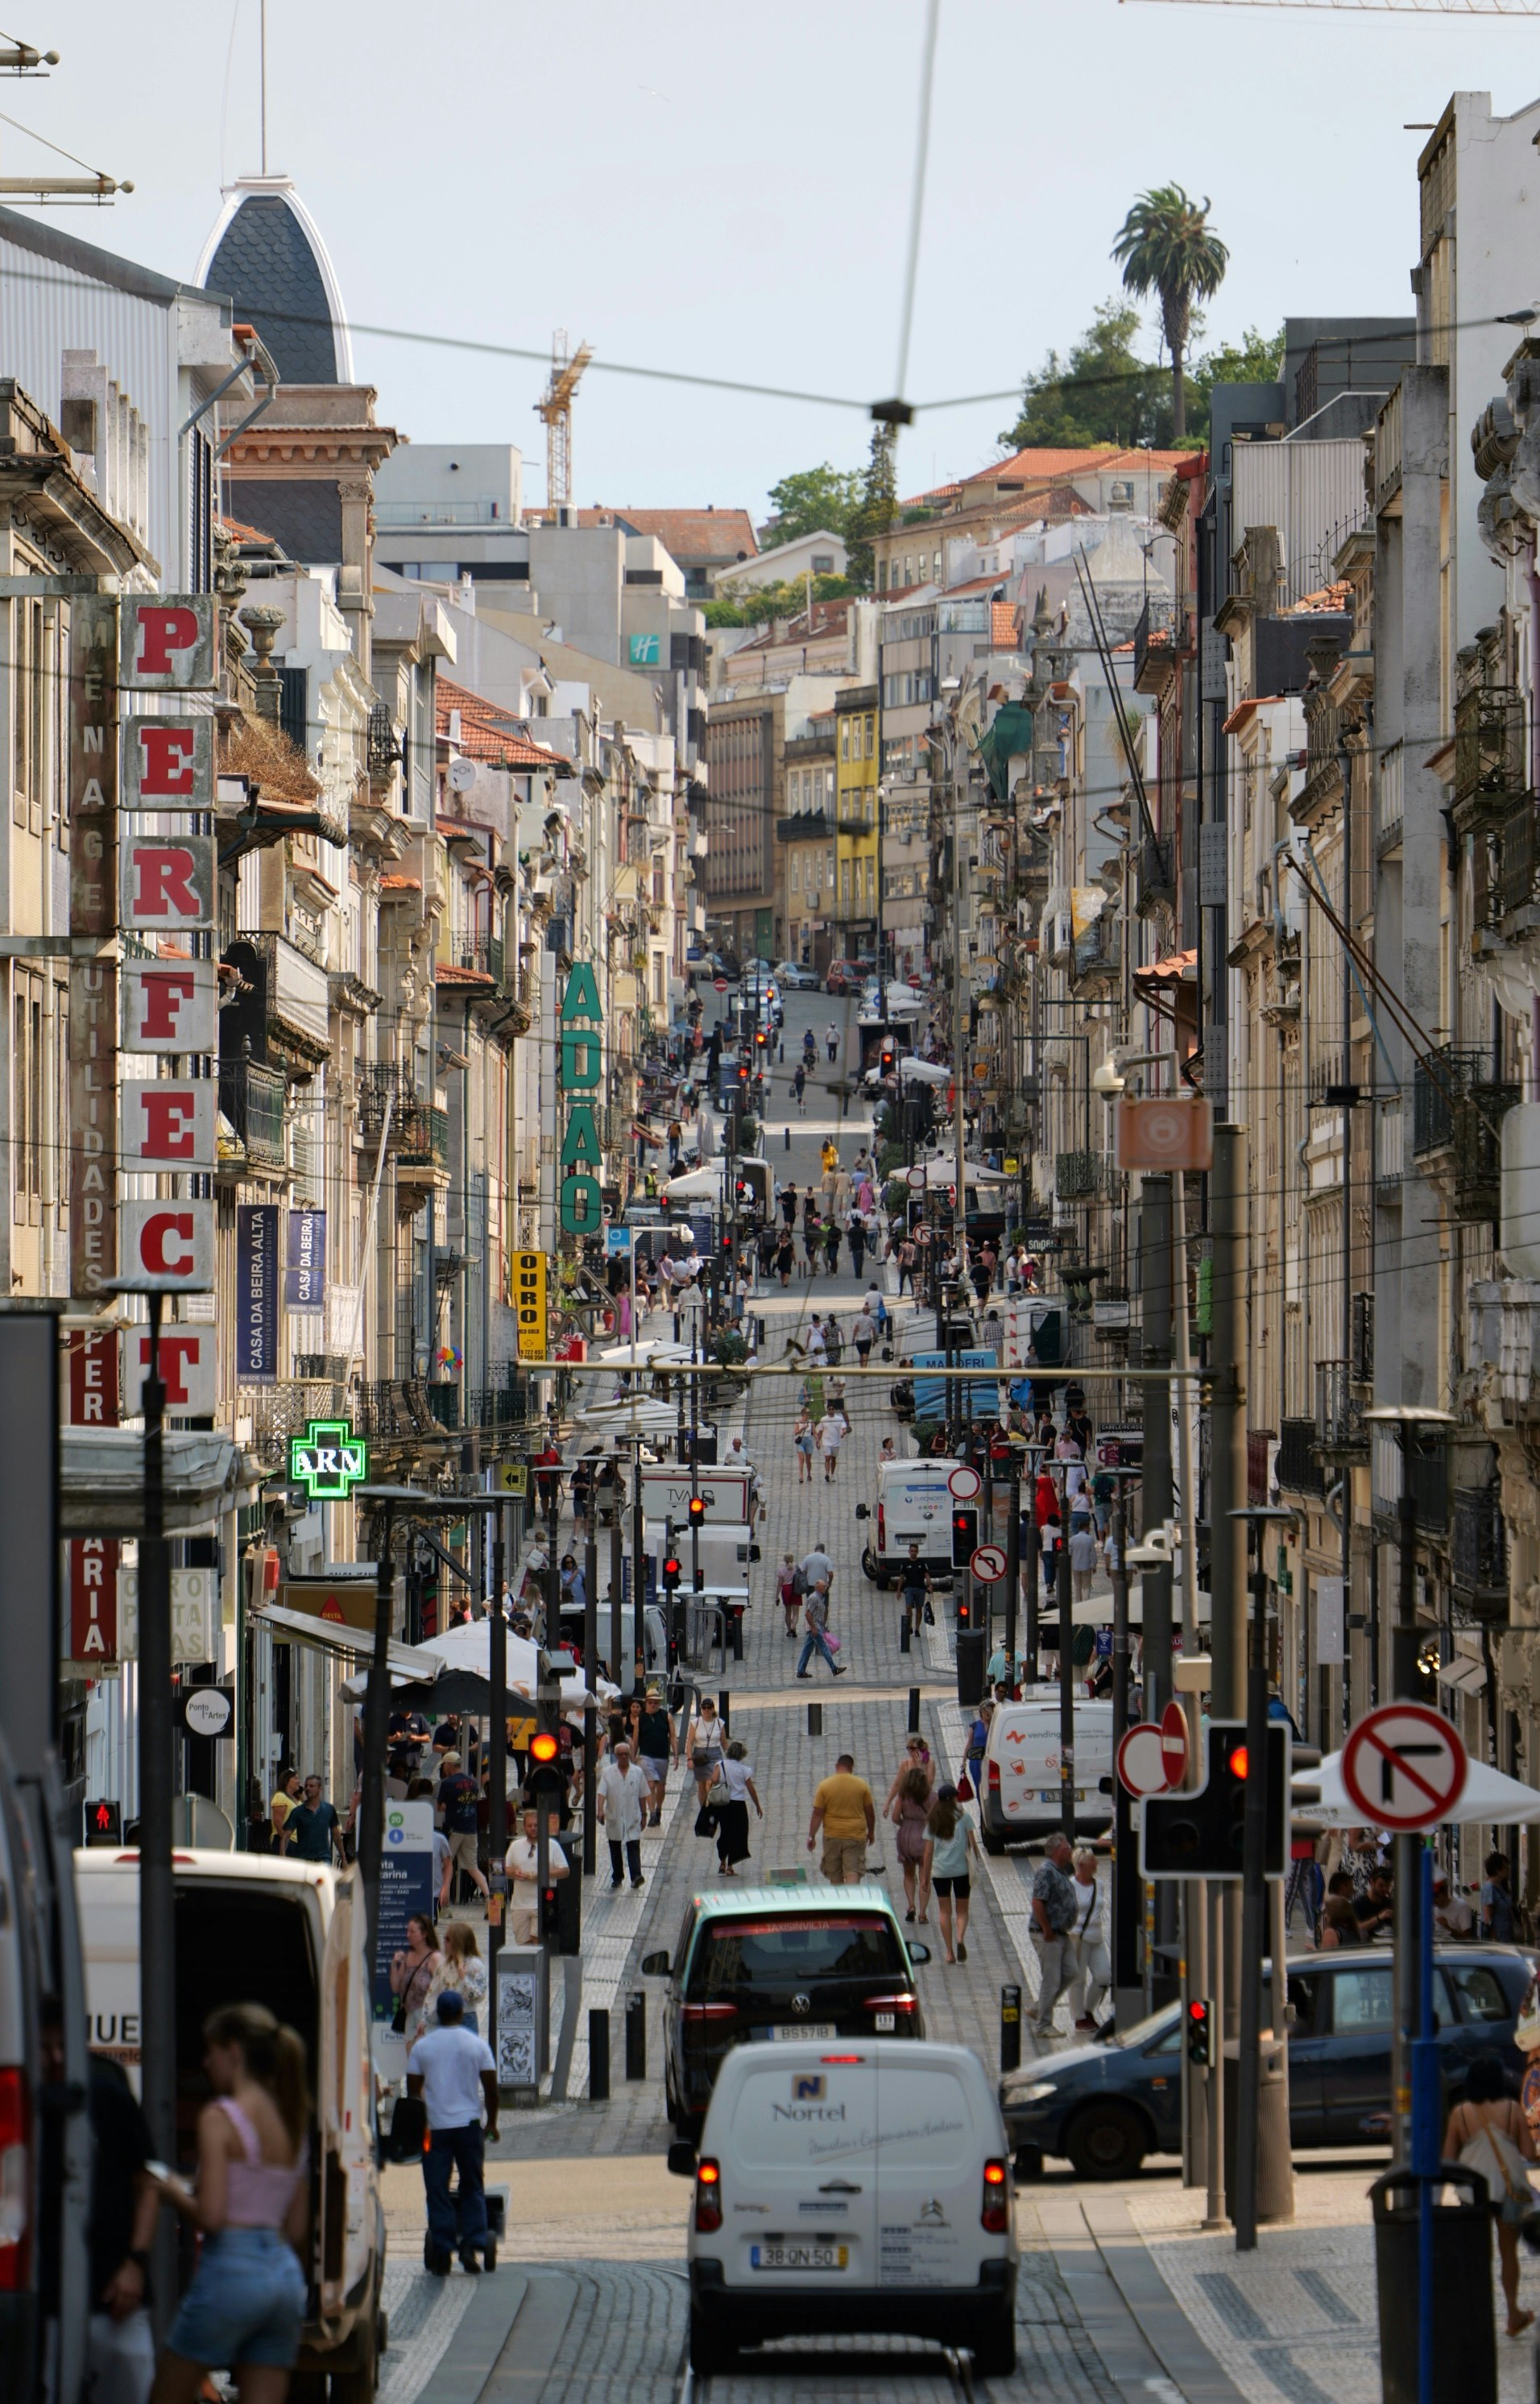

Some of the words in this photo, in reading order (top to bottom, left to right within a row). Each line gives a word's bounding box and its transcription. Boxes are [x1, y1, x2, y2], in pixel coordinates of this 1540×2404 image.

[82, 620, 106, 912] MENAGE
[134, 607, 200, 1404] PERFECT
[561, 963, 603, 1234] ADÃO
[82, 964, 104, 1292] UTILIDADES
[251, 1212, 264, 1249] ALTA
[301, 1217, 313, 1250] BEIRA
[251, 1252, 263, 1298] BEIRA
[300, 1252, 312, 1266] DA
[299, 1270, 311, 1300] CASA
[520, 1255, 537, 1324] OURO
[250, 1302, 263, 1323] DA
[250, 1327, 263, 1369] CASA
[124, 1576, 201, 1598] ORO
[124, 1604, 201, 1627] PTA
[124, 1632, 201, 1656] JAS
[1028, 1730, 1062, 1739] vending
[772, 2104, 846, 2122] Nortel
